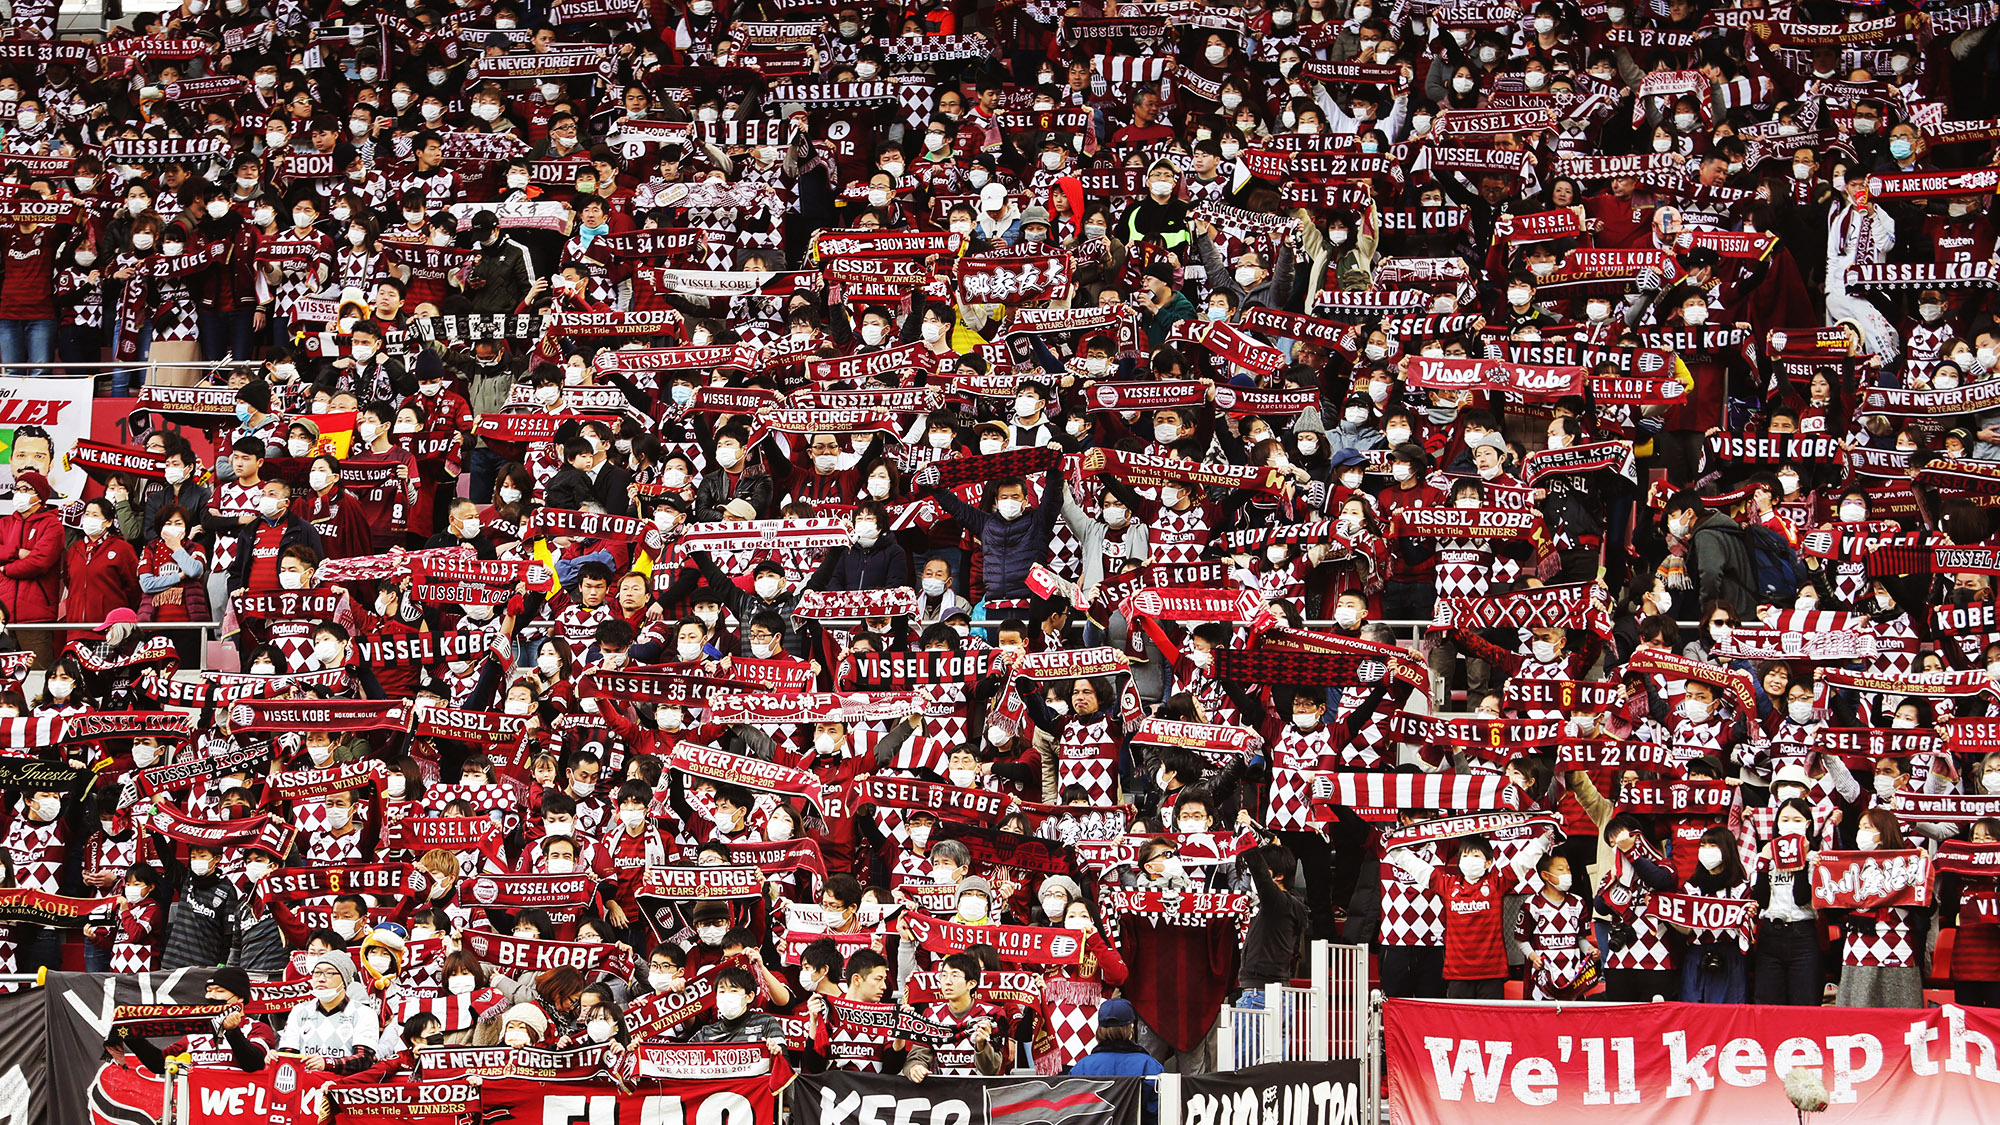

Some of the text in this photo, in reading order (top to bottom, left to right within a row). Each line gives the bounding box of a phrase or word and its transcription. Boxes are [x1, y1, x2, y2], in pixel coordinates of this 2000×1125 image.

[561, 0, 636, 15] VISSEL KOBE
[1440, 6, 1519, 20] VISSEL KOBE
[1074, 25, 1165, 38] VISSEL KOBE
[1780, 15, 1897, 36] VISSEL KOBE
[777, 83, 894, 100] VISSEL KOBE
[1834, 87, 1869, 95] FESTIVAL
[1924, 120, 1990, 136] VISSEL
[113, 139, 231, 155] VISSEL KOBE
[840, 142, 854, 154] 12
[1435, 148, 1521, 165] VISSEL KOBE
[1572, 155, 1641, 172] WE LOVE
[1886, 176, 1947, 192] WE ARE KOBE
[20, 203, 72, 215] KOBE
[1522, 214, 1574, 229] VISSEL
[1682, 213, 1718, 223] Rakuten
[1938, 237, 1974, 247] Rakuten
[154, 251, 207, 277] 22 KOBE
[1575, 252, 1661, 266] VISSEL KOBE
[412, 267, 445, 279] Rakuten
[1861, 262, 2000, 282] VISSEL KOBE
[682, 279, 752, 290] VISSEL KOBE
[1051, 286, 1066, 299] 27
[552, 311, 675, 327] VISSEL KOBE
[983, 345, 1006, 363] BE
[1510, 347, 1575, 366] VISSEL
[840, 348, 913, 378] BE KOBE
[1419, 360, 1571, 389] Vissel Kobe
[1123, 385, 1194, 398] VISSEL KOBE
[1614, 380, 1653, 393] KOBE
[703, 391, 760, 407] VISSEL KOBE
[1242, 392, 1315, 403] VISSEL KOBE
[1887, 391, 1963, 406] WE NEVER
[0, 399, 72, 426] LEX
[760, 410, 867, 424] NEVER FORGET
[1711, 438, 1838, 458] VISSEL KOBE
[80, 448, 154, 471] WE ARE KOBE
[1117, 450, 1259, 479] VISSEL KOBE
[1132, 467, 1147, 476] The
[1162, 470, 1181, 480] Title
[1188, 473, 1241, 487] WINNERS
[370, 489, 382, 501] 10
[392, 504, 403, 518] 8
[1402, 510, 1534, 529] VISSEL KOBE
[1418, 526, 1431, 534] The
[1433, 527, 1445, 535] 1st
[1469, 528, 1518, 537] WINNERS
[704, 538, 801, 550] walk together
[1441, 551, 1479, 562] Rakuten
[422, 558, 519, 575] VISSEL KOBE
[654, 574, 669, 590] 10
[1164, 598, 1234, 612] VISSEL KOBE
[1937, 605, 1995, 630] KOBE
[1732, 628, 1780, 638] VISSEL KOBE
[359, 632, 496, 661] VISSEL KOBE
[857, 654, 988, 678] VISSEL KOBE
[141, 676, 264, 701] VISSEL KOBE
[1854, 678, 1946, 694] 20 YEARS 1995-2015
[263, 710, 331, 722] VISSEL KOBE
[1152, 720, 1220, 741] NEVER FORGET
[1063, 745, 1100, 758] Rakuten
[145, 745, 270, 786] VISSEL KOBE
[678, 743, 798, 783] NEVER FORGET
[20, 762, 77, 782] Iniesta
[855, 782, 1002, 815] VISSEL 13 KOBE
[825, 799, 841, 817] 12
[1779, 838, 1798, 856] 34
[760, 849, 786, 863] KOBE
[258, 870, 400, 900] VISSEL 8 KOBE
[505, 880, 585, 895] VISSEL KOBE
[1450, 900, 1490, 913] Rakuten
[1659, 896, 1749, 930] BE KOBE
[940, 925, 1043, 950] VISSEL KOBE
[500, 941, 603, 972] BE KOBE
[1572, 968, 1597, 989] JAPAN
[652, 978, 712, 1013] KOBE
[838, 1008, 953, 1039] VISSEL KOBE
[191, 1052, 232, 1062] Rakuten
[712, 1048, 761, 1064] KOBE
[830, 1044, 874, 1057] Rakuten
[422, 1048, 602, 1070] WE NEVER FORGET 1.17
[477, 1067, 556, 1077] YEARS 1995-2015
[1423, 1035, 1641, 1106] We'll
[1662, 1029, 1884, 1105] keep
[347, 1104, 466, 1115] The 1st Title WINNERS
